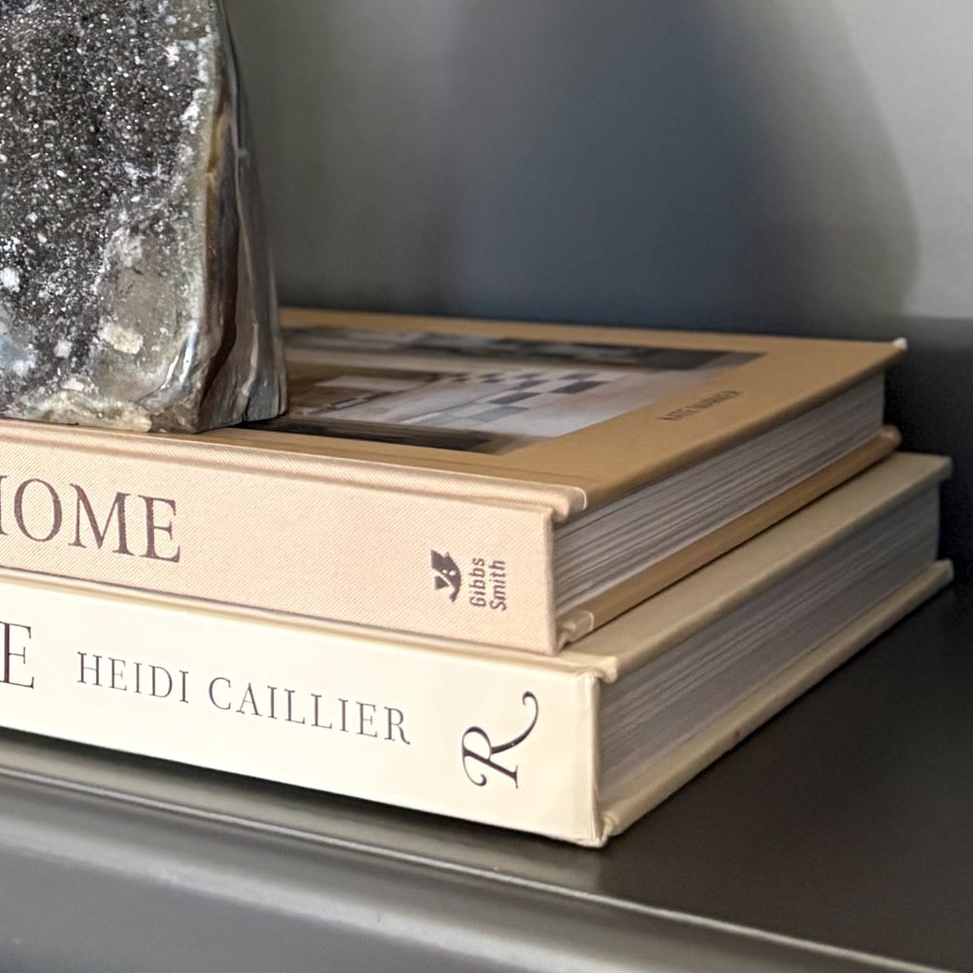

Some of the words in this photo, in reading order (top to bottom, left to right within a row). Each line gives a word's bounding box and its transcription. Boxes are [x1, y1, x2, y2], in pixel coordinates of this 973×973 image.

[468, 557, 486, 607] Gibbs
[488, 559, 507, 611] Smith
[77, 651, 190, 703] HEIDI
[208, 677, 411, 745] CAILLIER
[462, 691, 539, 789] R
